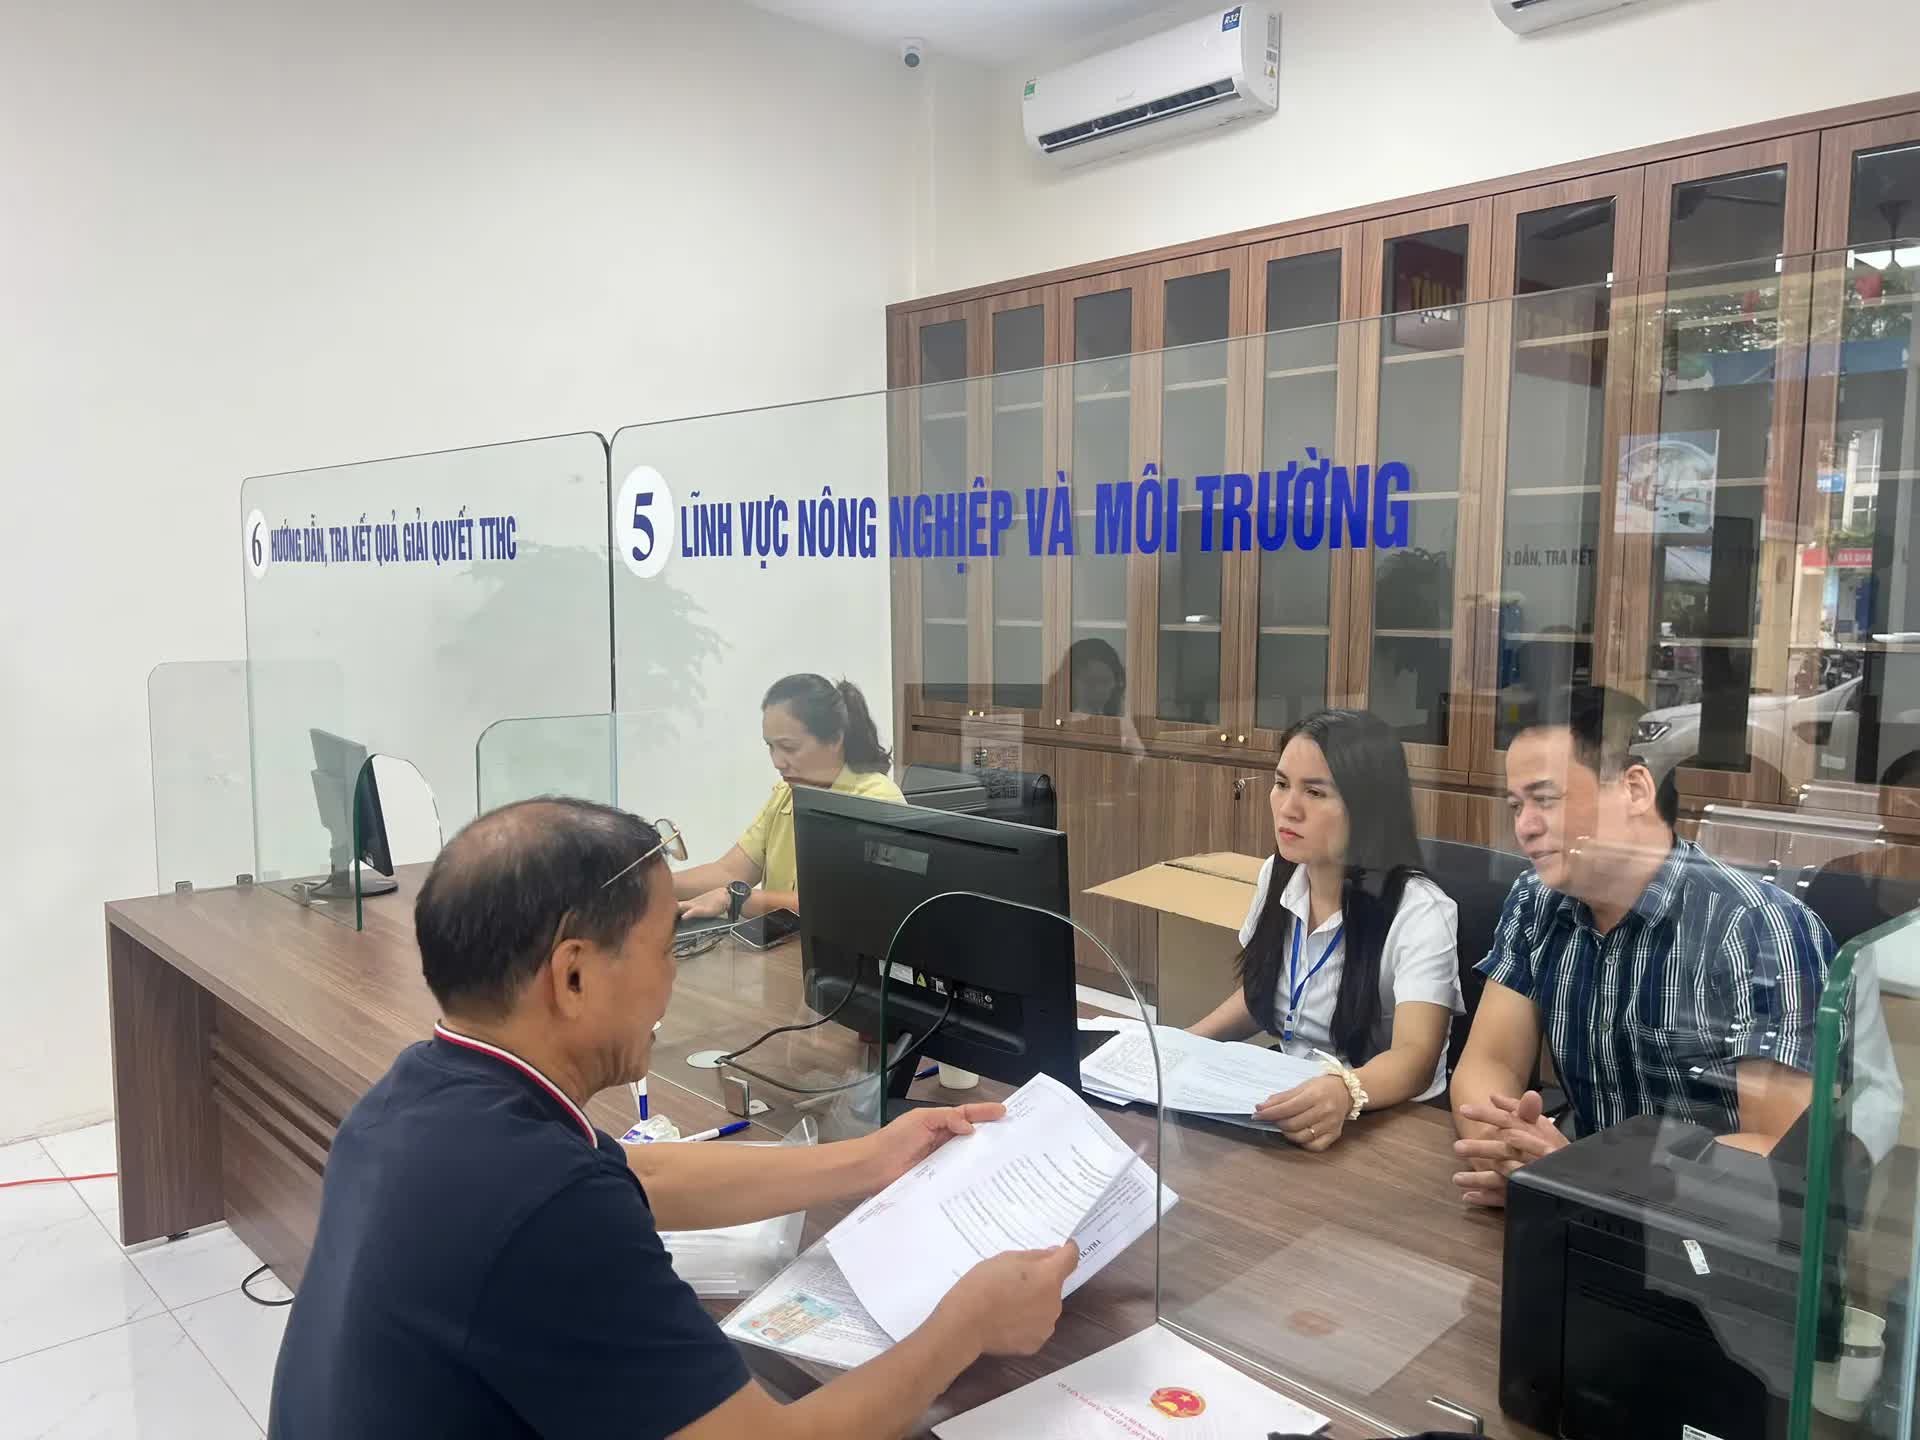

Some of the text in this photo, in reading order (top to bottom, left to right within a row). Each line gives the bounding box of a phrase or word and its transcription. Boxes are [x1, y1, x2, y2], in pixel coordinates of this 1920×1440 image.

[251, 504, 517, 567] 6 HƯỚNG DẪN, TRA KẾT QUẢ GIẢI QUYẾT TTHC
[631, 447, 1410, 574] 5 LĨNH VỰC NÔNG NGHIỆP VÀ MÔI TRƯỜNG
